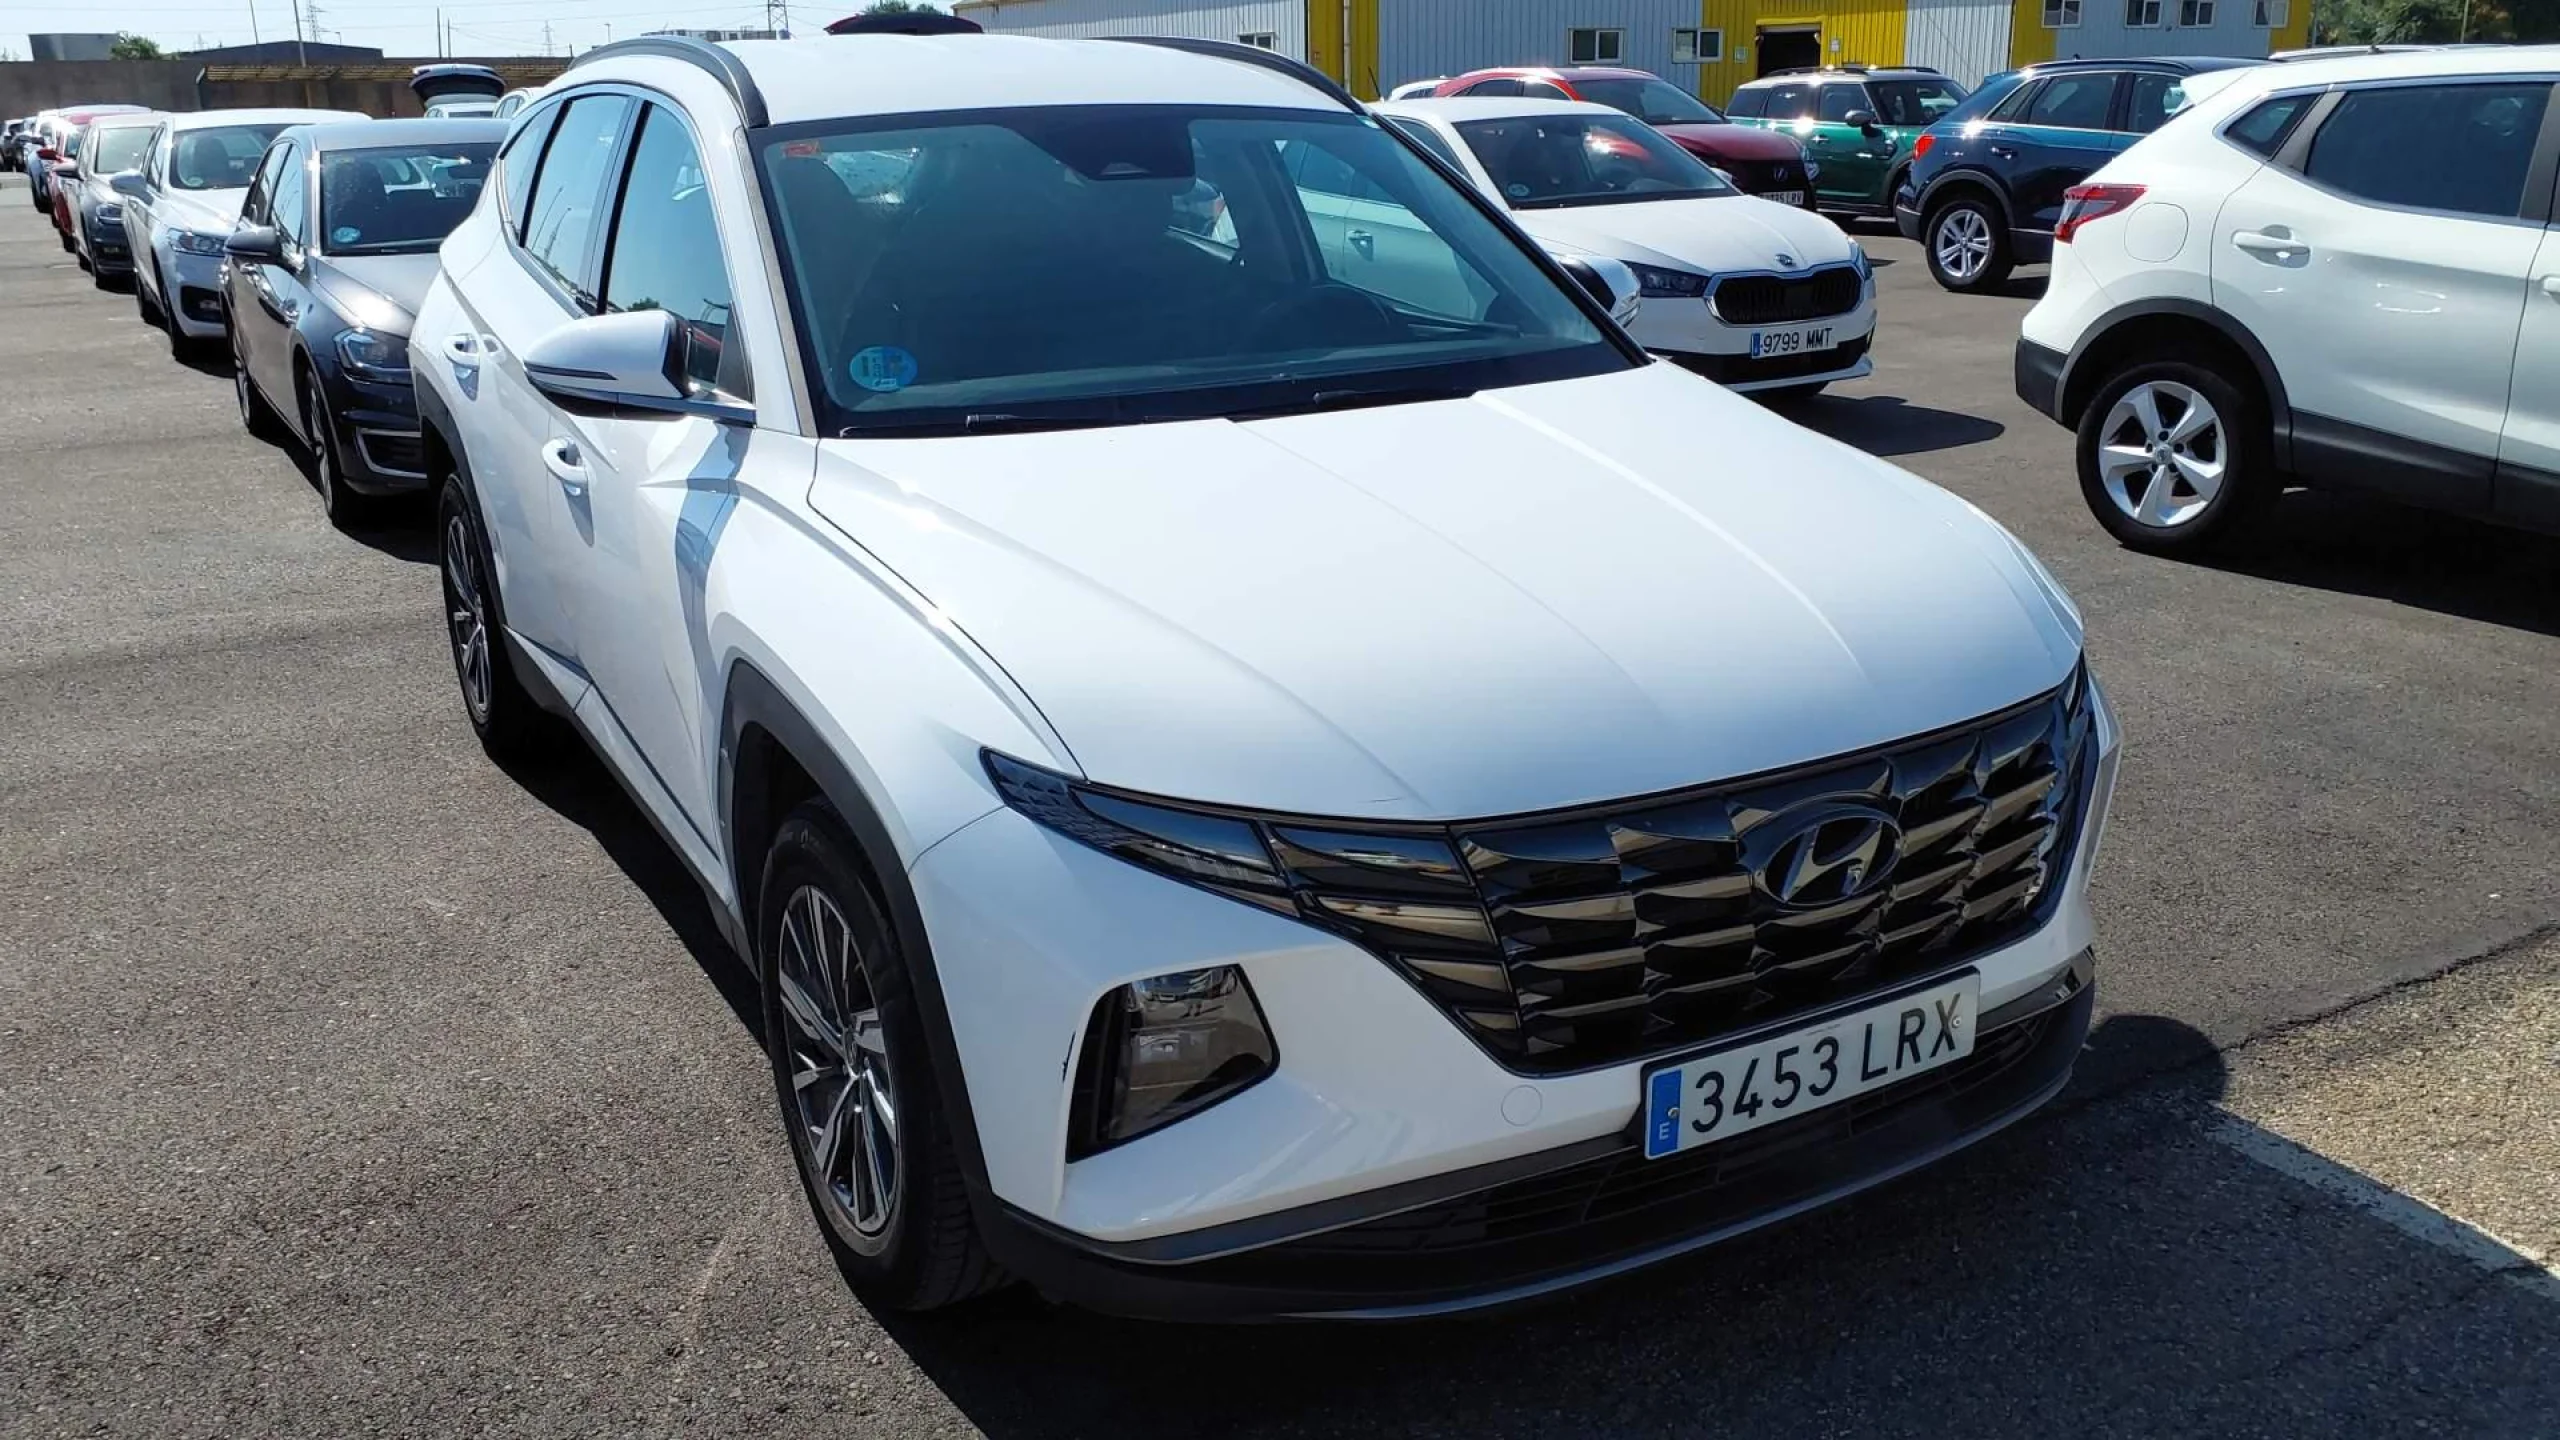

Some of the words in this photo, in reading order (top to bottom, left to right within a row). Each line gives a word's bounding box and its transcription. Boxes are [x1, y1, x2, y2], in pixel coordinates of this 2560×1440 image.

[1763, 331, 1800, 353] 9799
[1806, 327, 1833, 349] MMT
[1691, 1035, 1840, 1133] 3453
[1860, 992, 1961, 1082] LRX
[1658, 1121, 1670, 1141] E
